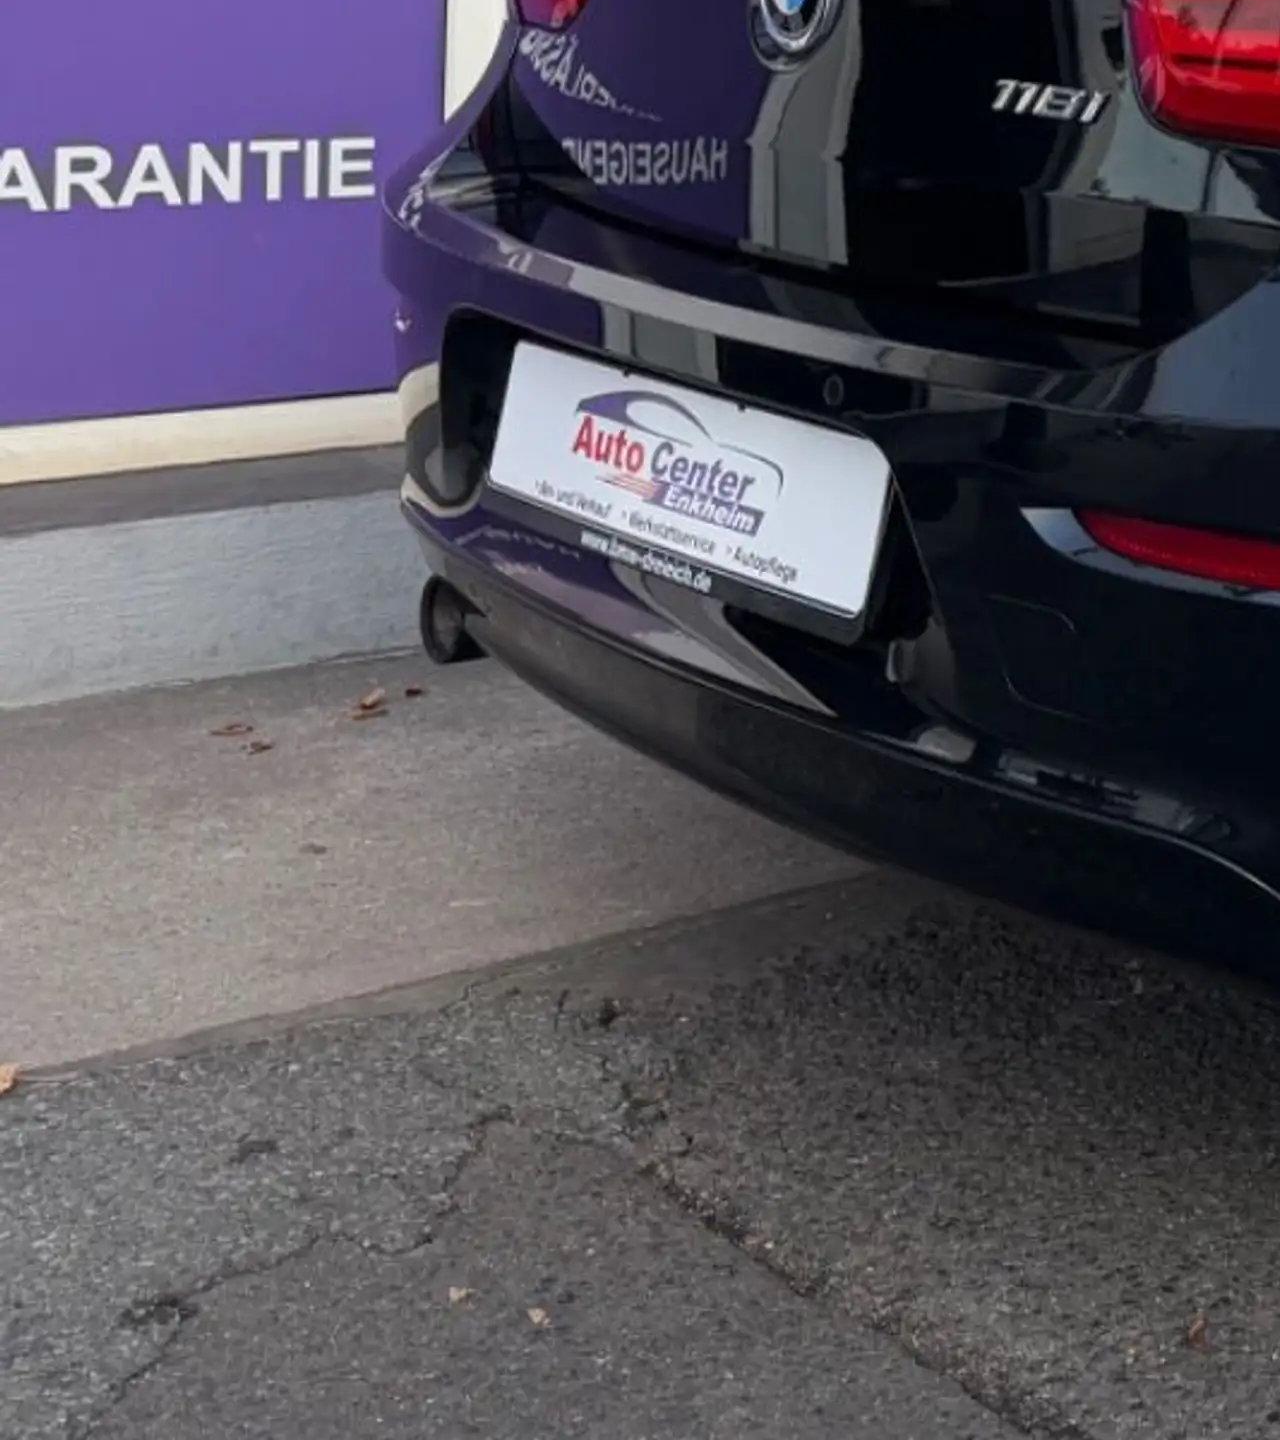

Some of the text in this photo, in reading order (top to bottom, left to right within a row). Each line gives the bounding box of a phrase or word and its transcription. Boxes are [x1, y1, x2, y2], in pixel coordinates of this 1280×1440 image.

[0, 138, 375, 212] ARANTIE
[571, 415, 756, 501] Auto Center
[663, 485, 756, 532] Enkheim
